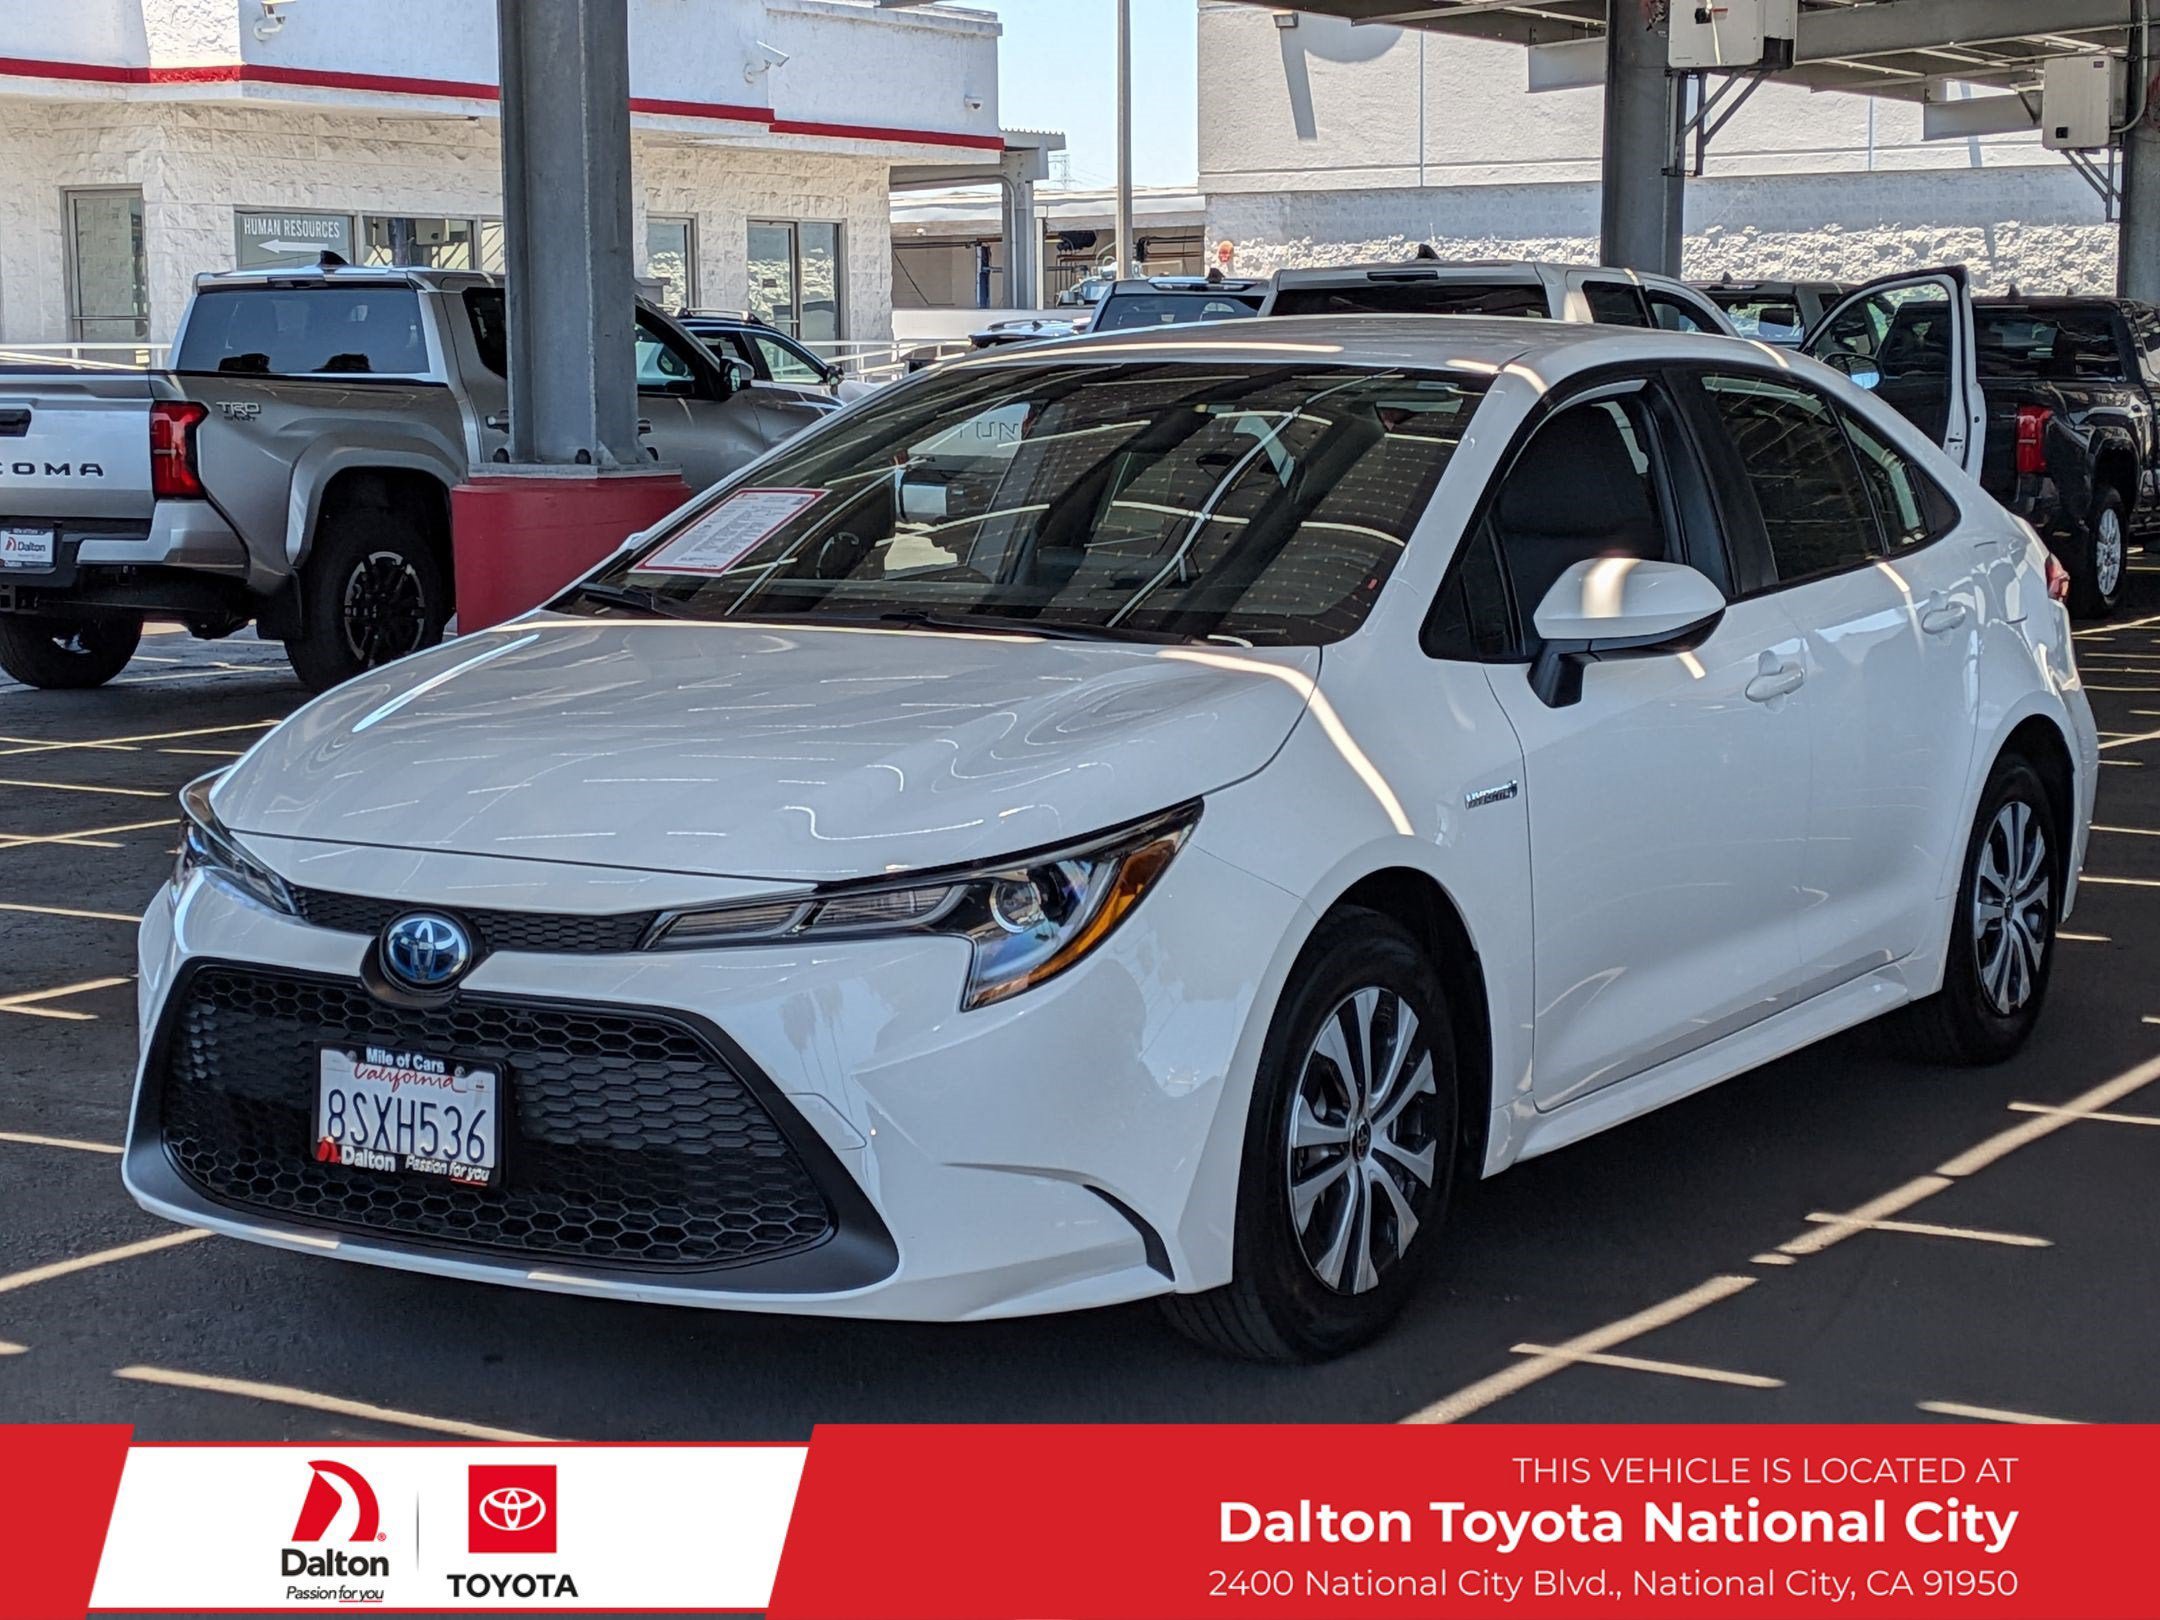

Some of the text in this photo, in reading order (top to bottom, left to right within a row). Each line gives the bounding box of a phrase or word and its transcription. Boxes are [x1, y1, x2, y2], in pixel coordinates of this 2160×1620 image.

[244, 218, 340, 238] HUMAN RESOURCES
[215, 401, 261, 416] TRD
[0, 462, 104, 477] OMA
[17, 541, 46, 552] Dalton
[366, 1046, 445, 1074] Mile of Cars
[354, 1062, 467, 1093] California
[328, 1089, 487, 1164] 8SXH536
[341, 1145, 396, 1172] Dalton
[405, 1154, 490, 1182] Passion for you
